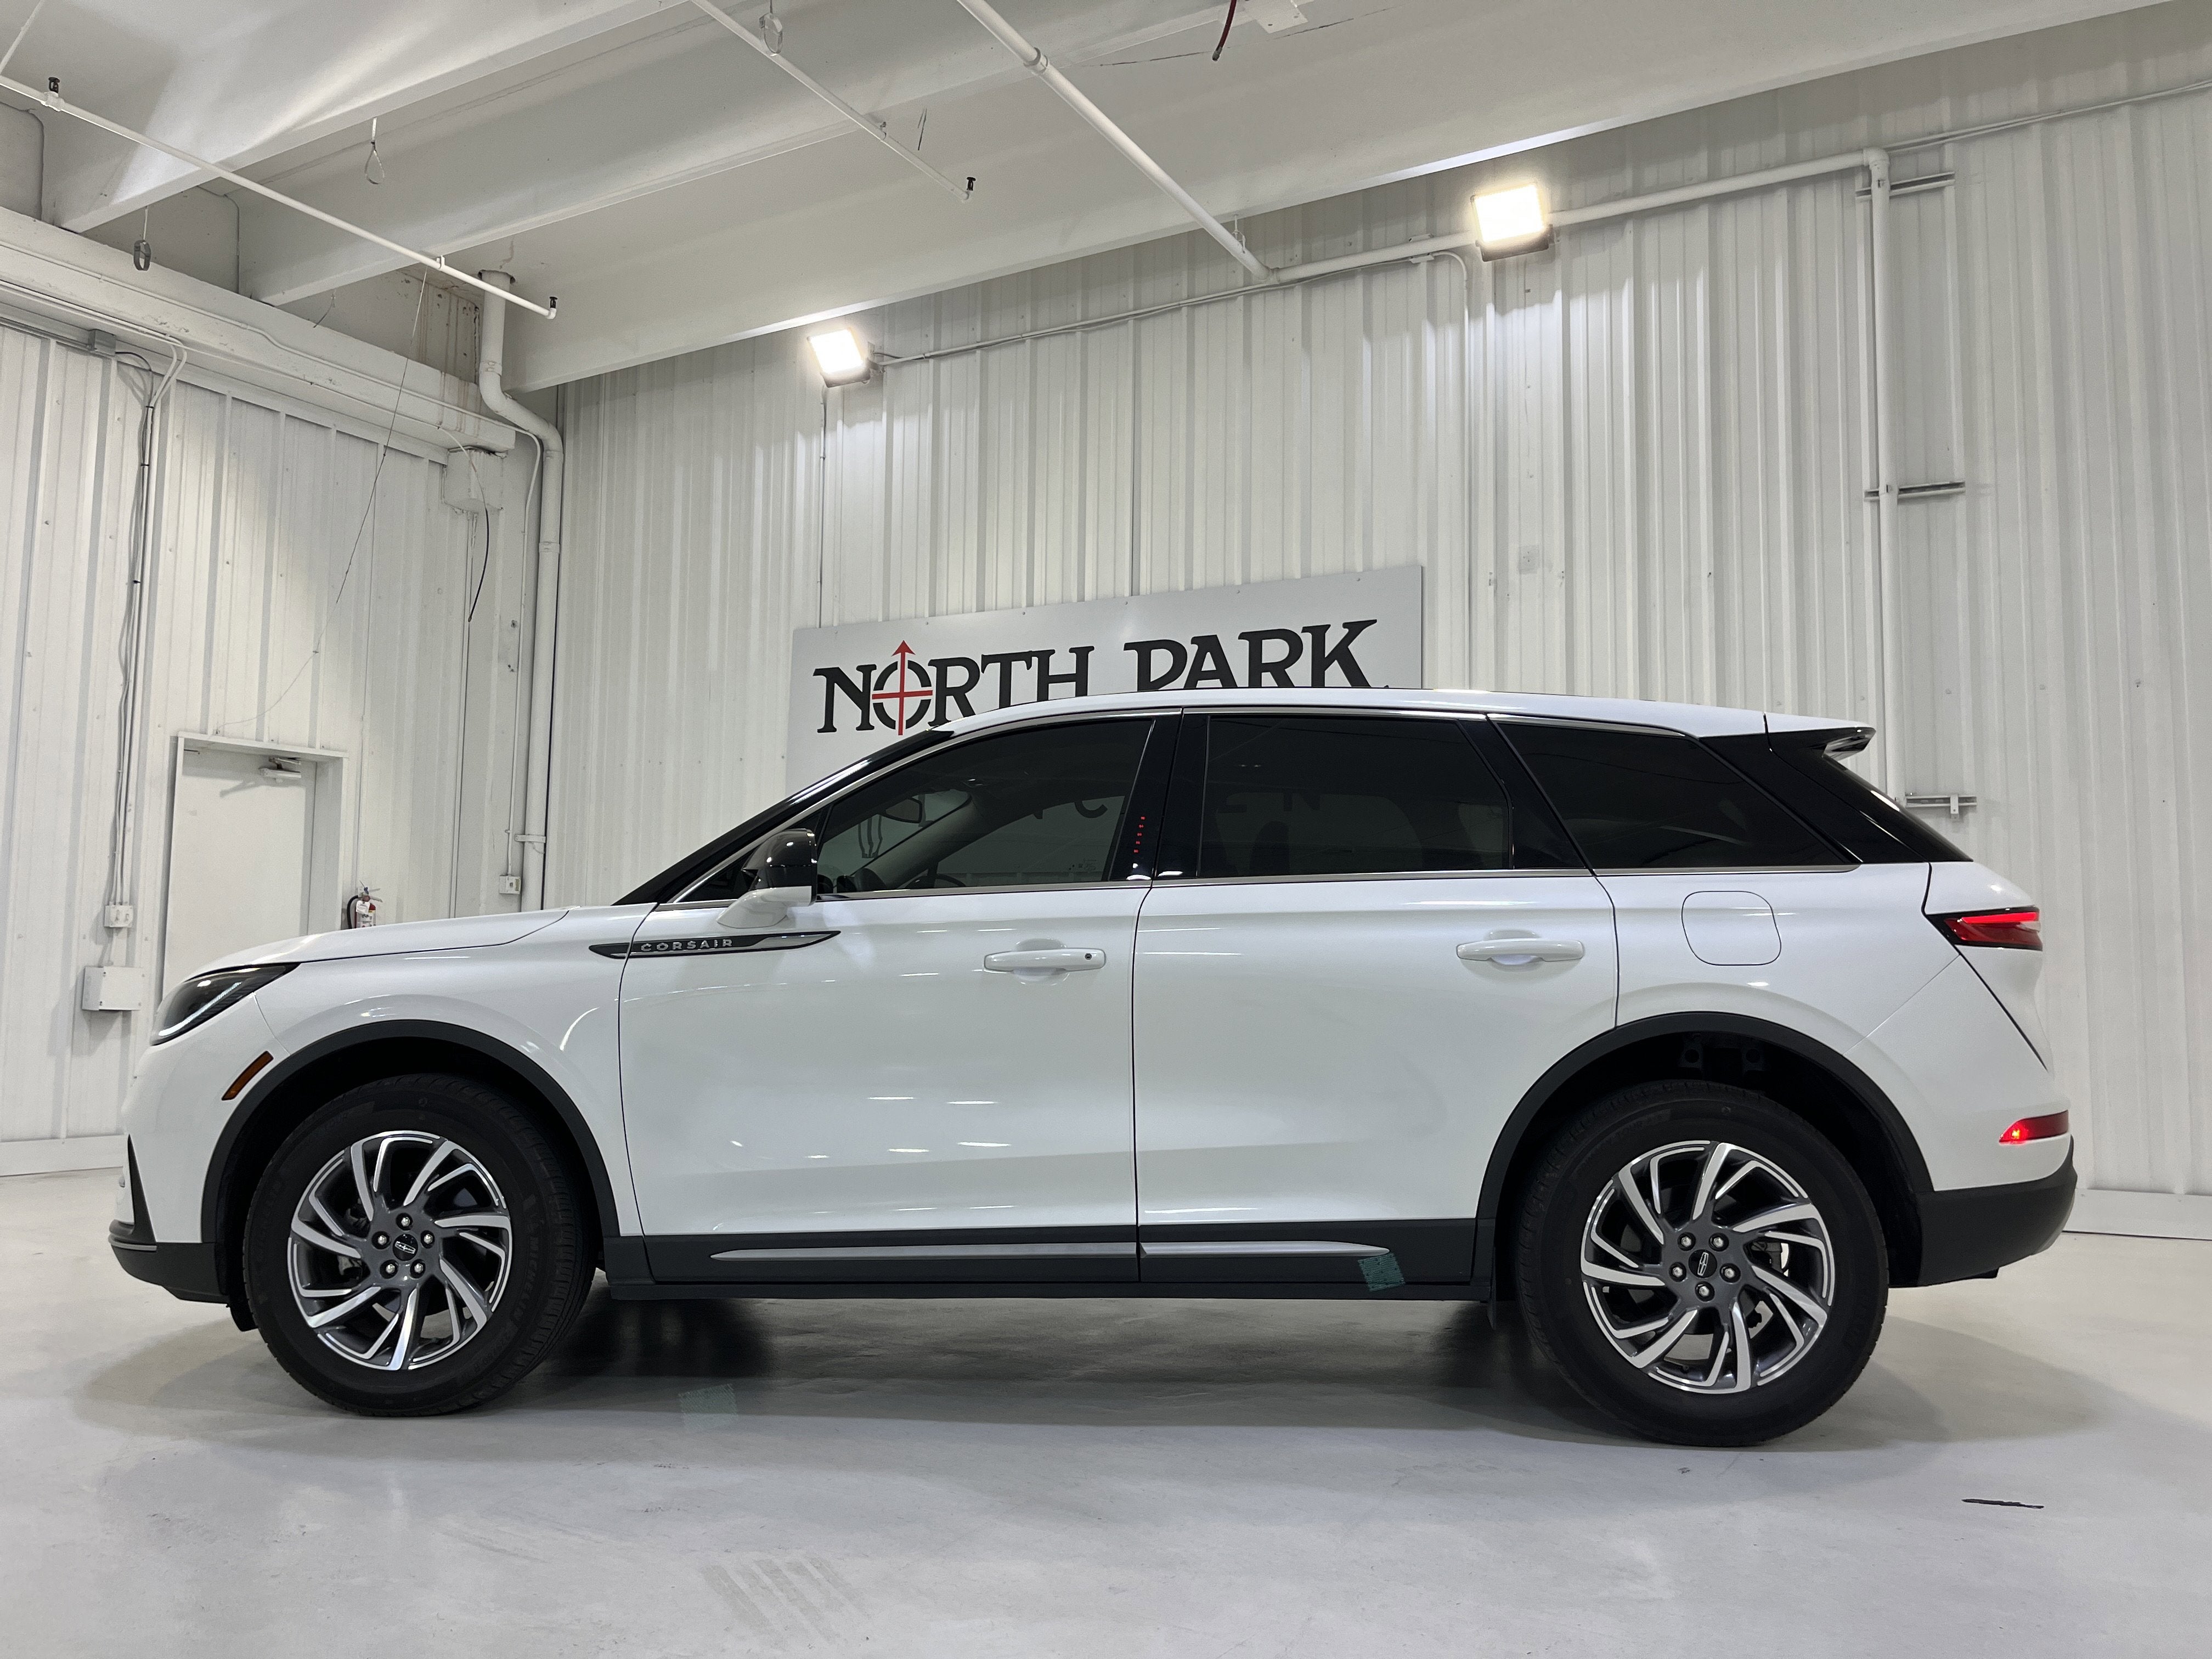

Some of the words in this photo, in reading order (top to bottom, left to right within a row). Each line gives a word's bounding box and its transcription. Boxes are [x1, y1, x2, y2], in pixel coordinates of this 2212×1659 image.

[812, 646, 1094, 733] NORTH
[1124, 619, 1389, 691] PARK
[641, 939, 733, 951] CORSAIR
